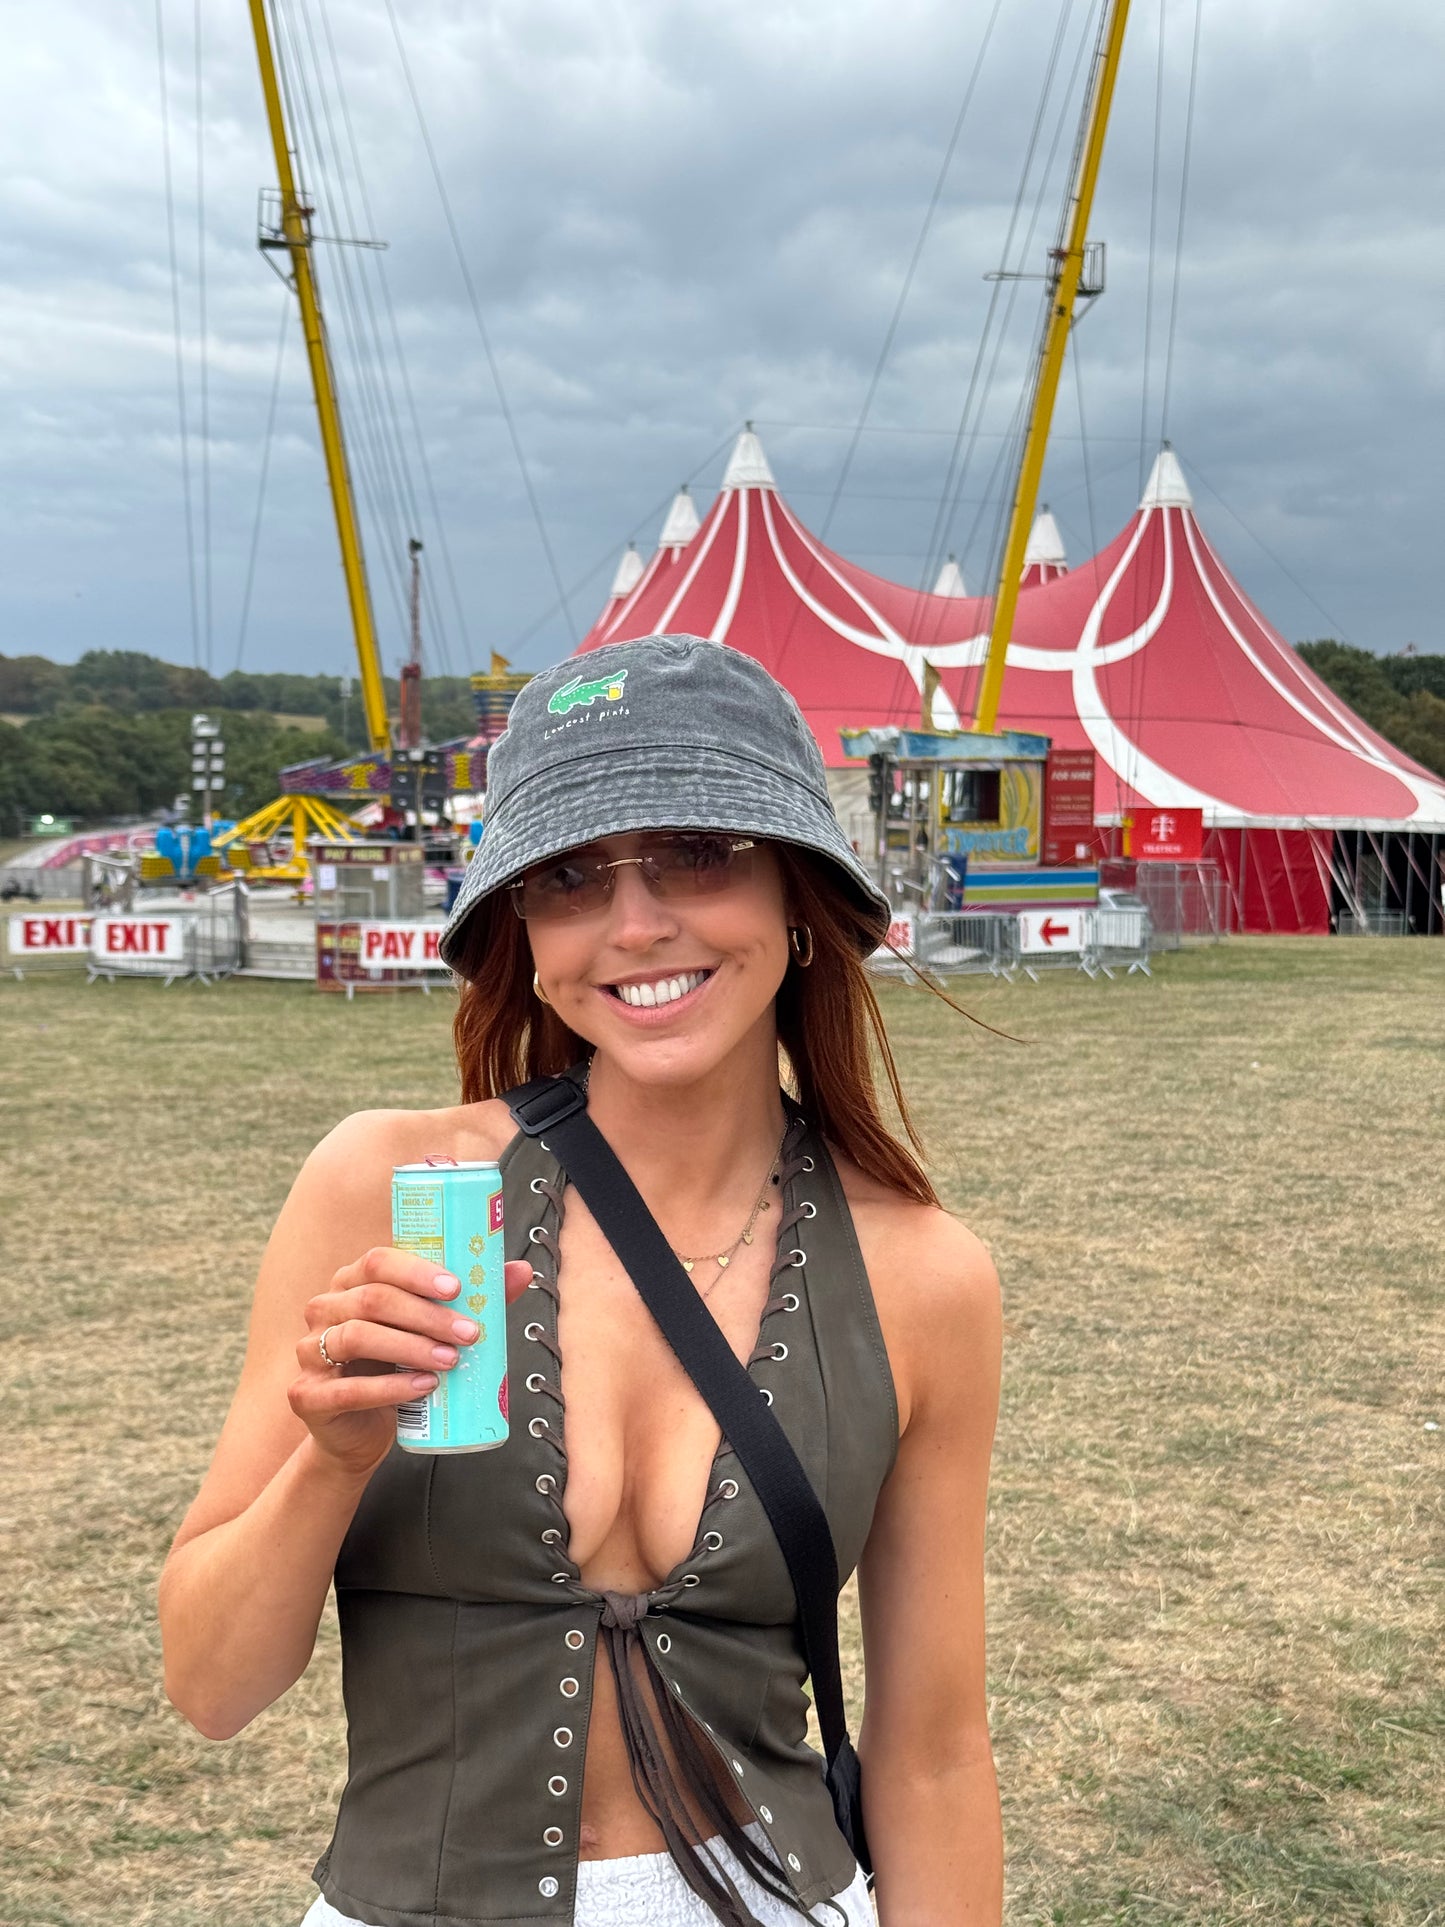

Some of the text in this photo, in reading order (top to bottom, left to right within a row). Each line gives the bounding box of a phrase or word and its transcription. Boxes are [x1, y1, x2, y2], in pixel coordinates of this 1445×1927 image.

[544, 705, 630, 740] Lowcost pints
[325, 848, 347, 860] PAY
[352, 848, 385, 861] HERE
[23, 919, 93, 947] EXIT
[106, 923, 170, 953] EXIT
[366, 931, 416, 958] PAY
[423, 931, 441, 959] H
